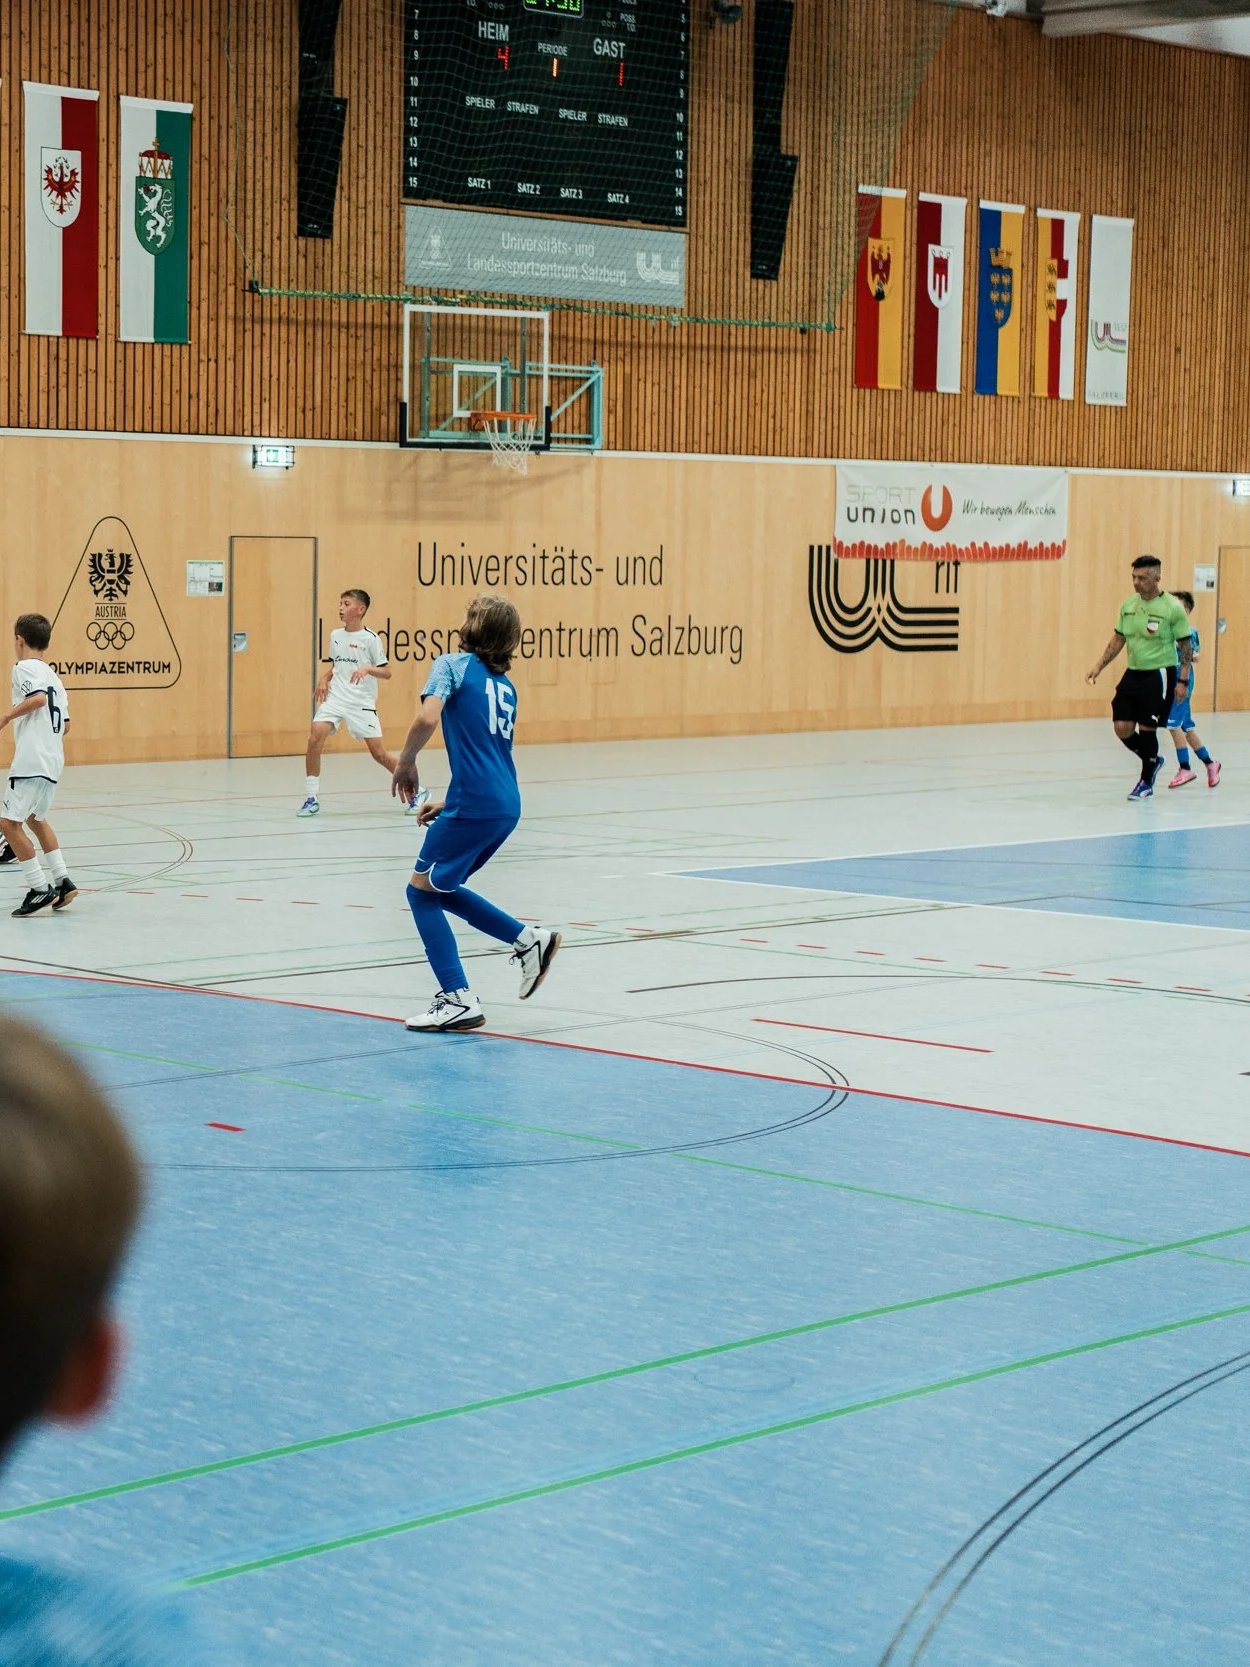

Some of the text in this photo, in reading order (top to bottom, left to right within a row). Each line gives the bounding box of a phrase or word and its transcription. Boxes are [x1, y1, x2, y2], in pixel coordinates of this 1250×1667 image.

[478, 20, 509, 42] HEIM
[537, 42, 569, 56] PERIODE
[593, 37, 626, 58] GAST
[497, 45, 510, 70] 4
[552, 57, 558, 78] 1
[410, 76, 419, 87] 10
[410, 97, 418, 107] 11
[465, 96, 539, 115] SPIELER STRAFEN
[409, 117, 418, 127] 12
[558, 108, 628, 127] SPIELER STRAFEN
[676, 112, 684, 123] 10
[409, 137, 418, 147] 13
[676, 131, 683, 141] 11
[409, 157, 418, 167] 14
[675, 150, 683, 161] 12
[675, 168, 683, 179] 13
[409, 177, 417, 188] 15
[467, 177, 486, 189] SATZ
[517, 182, 540, 195] SATZ 2
[560, 187, 583, 200] SATZ 3
[607, 192, 624, 204] SATZ
[674, 187, 683, 198] 14
[674, 205, 682, 216] 15
[501, 231, 595, 258] Universitäts- und
[467, 252, 627, 287] Landessportzentrum Salzburg
[846, 506, 916, 525] union
[961, 499, 1057, 521] Wir bewegen Menschen
[417, 541, 664, 587] Universitäts- und
[94, 605, 127, 618] AUSTRIA
[631, 614, 743, 664] Salzburg
[49, 661, 171, 675] OLYMPIAZENTRUM
[47, 685, 62, 734] 6
[485, 677, 514, 740] 15
